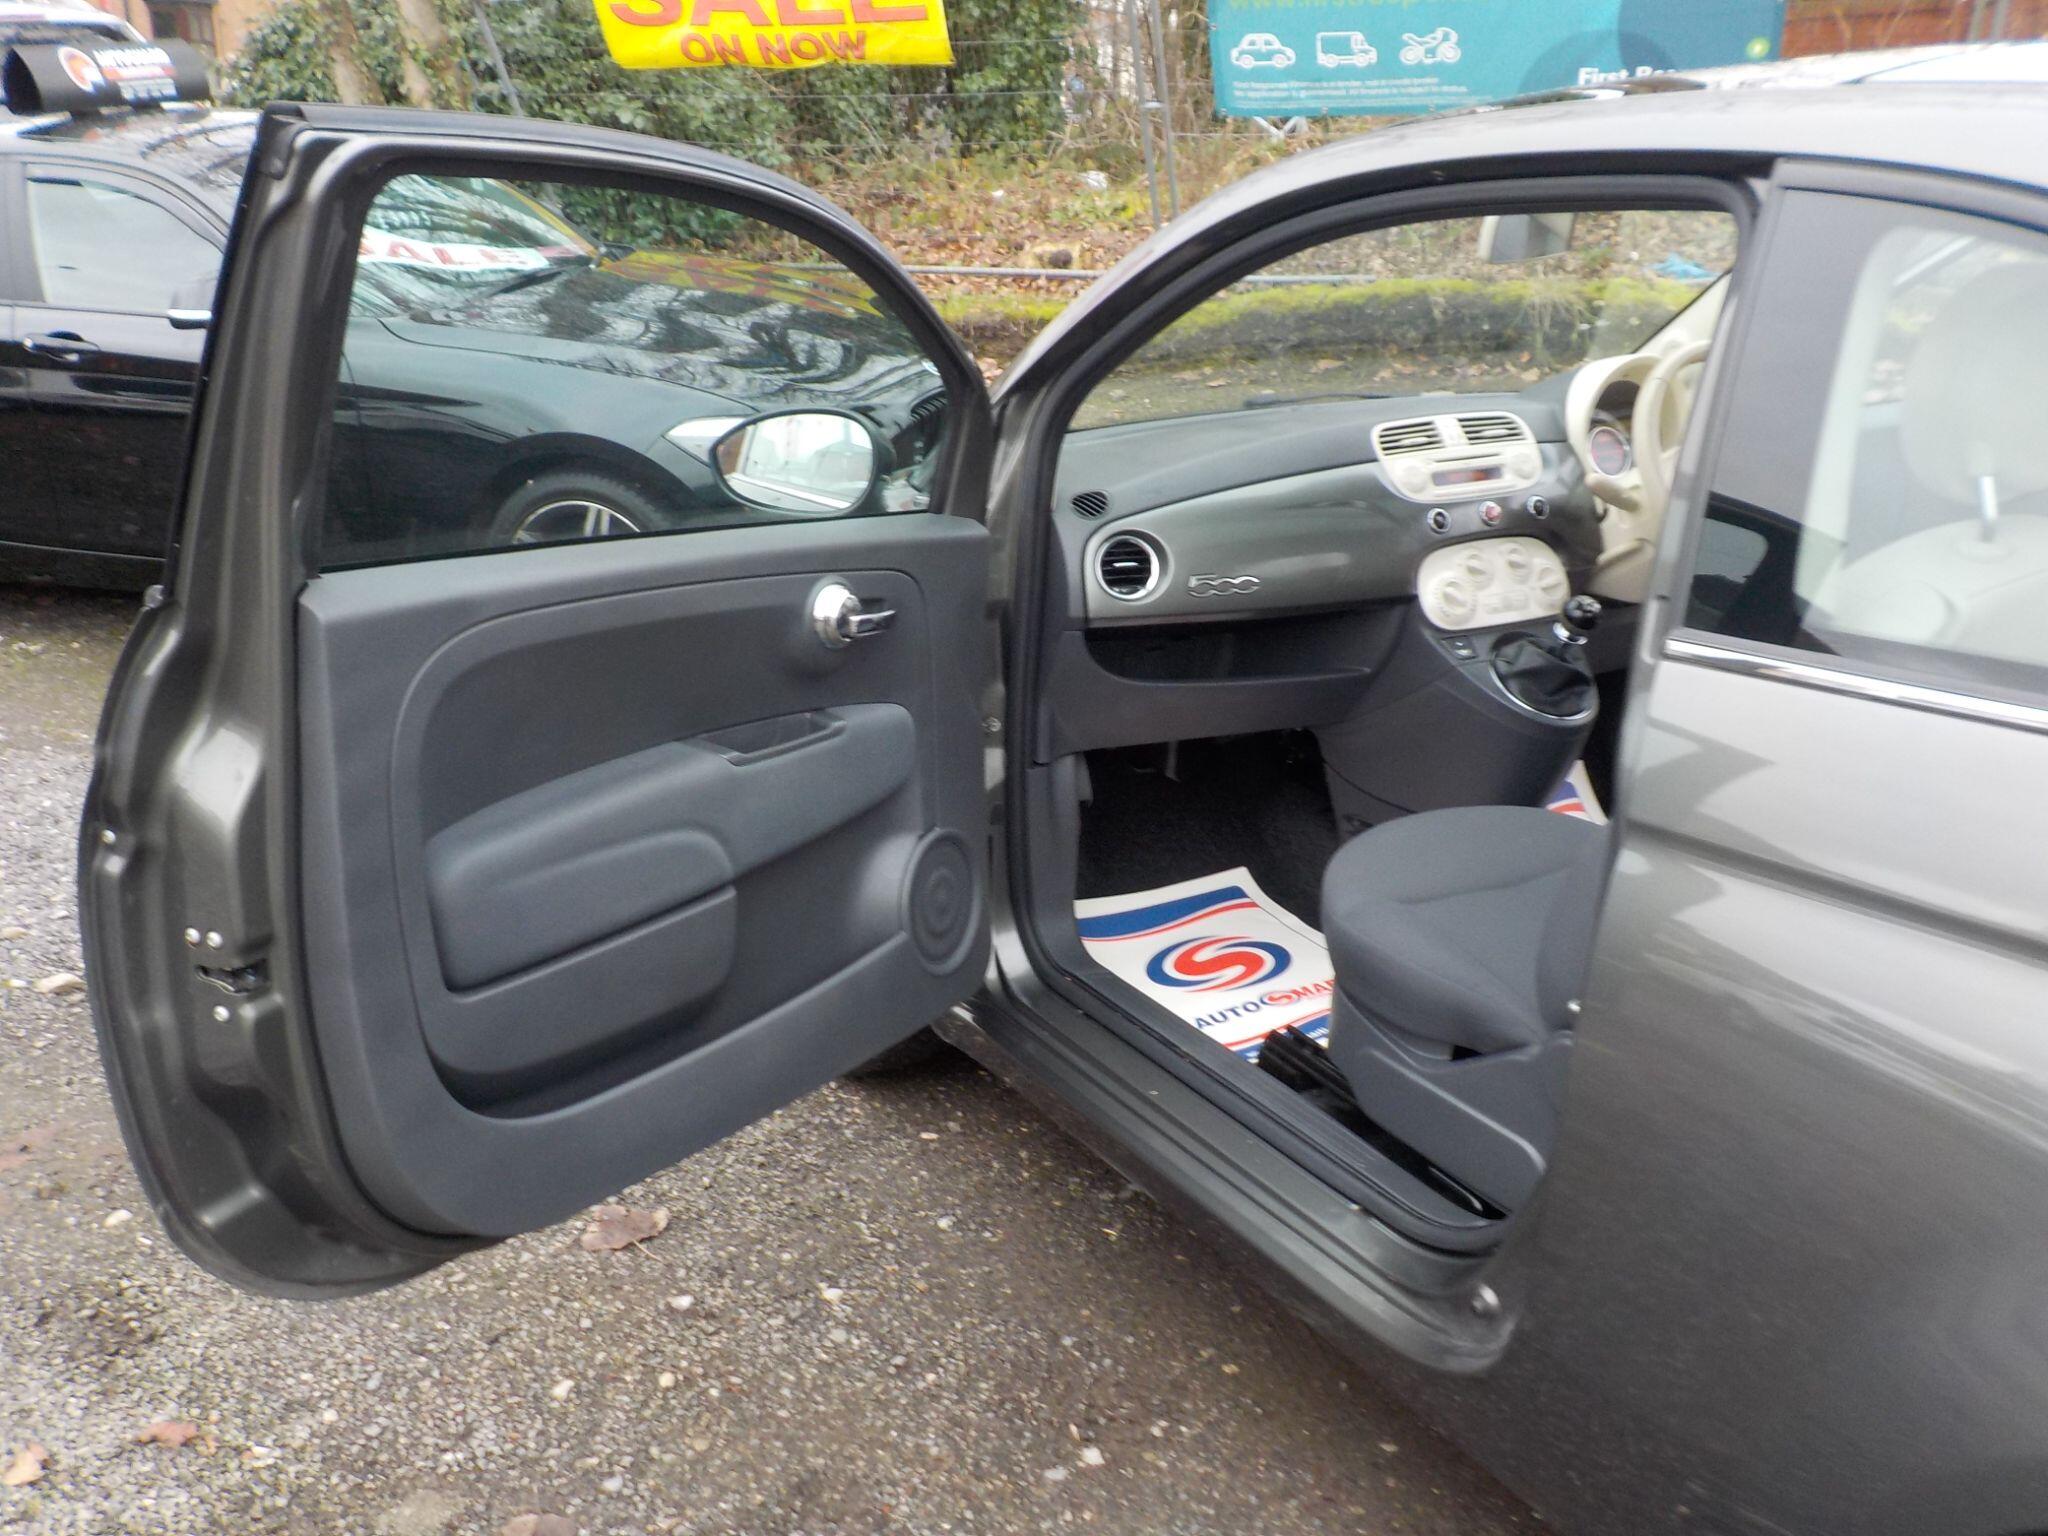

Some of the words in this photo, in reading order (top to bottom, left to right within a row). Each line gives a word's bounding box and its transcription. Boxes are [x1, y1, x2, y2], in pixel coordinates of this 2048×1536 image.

[681, 33, 749, 65] ON
[756, 31, 867, 65] NOW
[1187, 573, 1261, 599] 500
